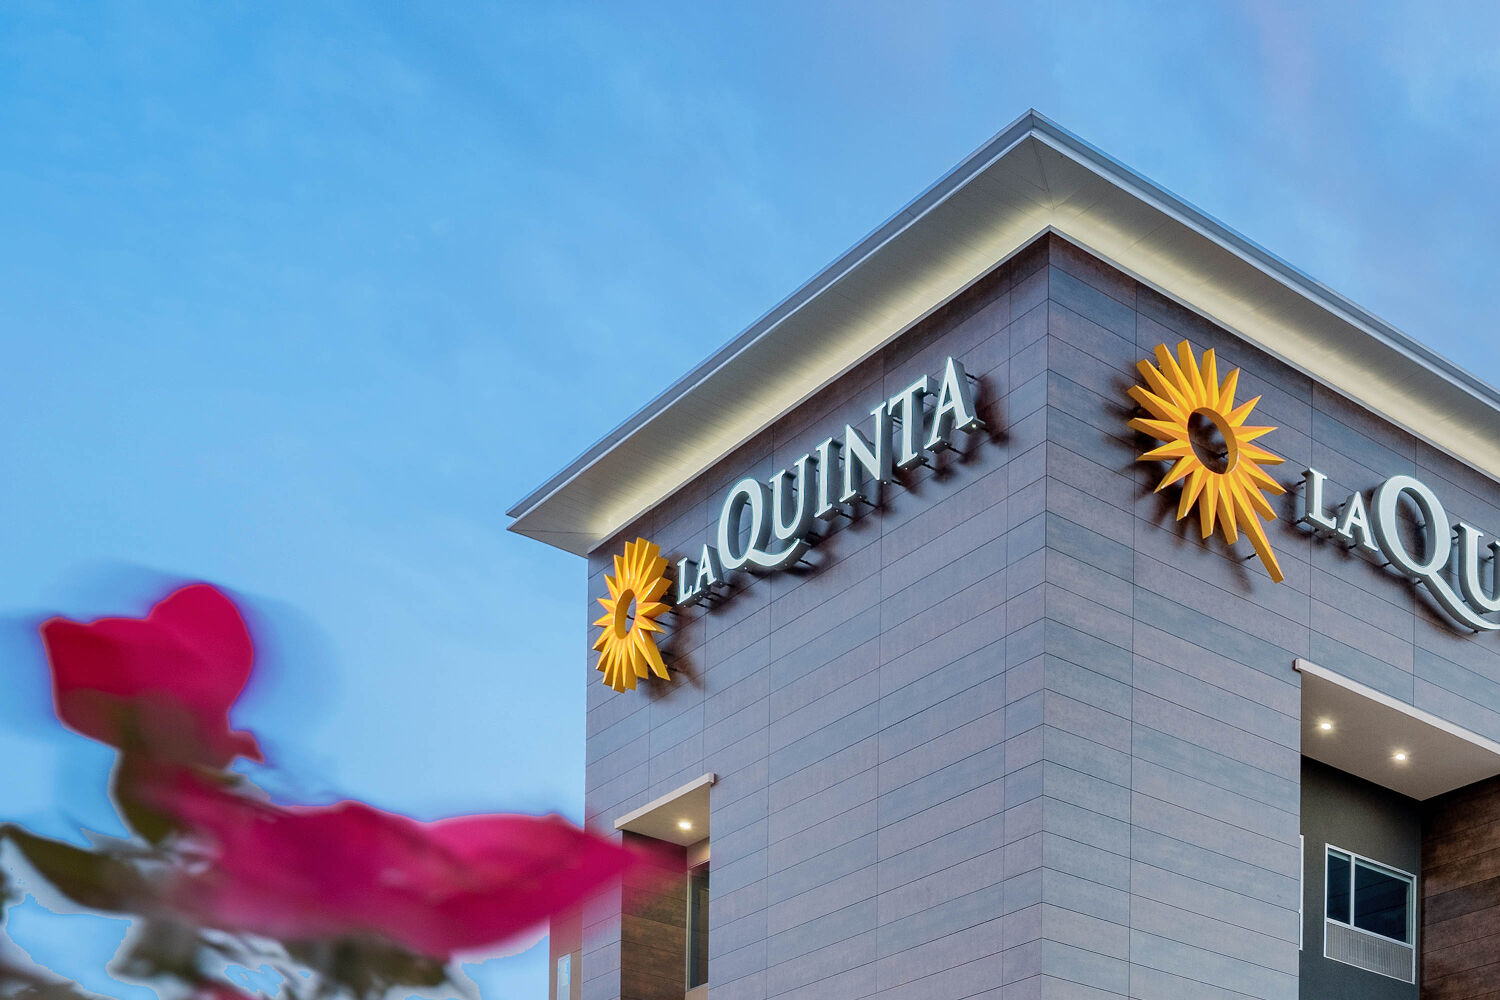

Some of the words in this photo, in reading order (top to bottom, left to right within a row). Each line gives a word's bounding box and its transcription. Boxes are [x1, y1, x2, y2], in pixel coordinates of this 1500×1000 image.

[676, 543, 719, 606] LA
[717, 356, 983, 569] QUINTA
[1306, 467, 1379, 551] LA
